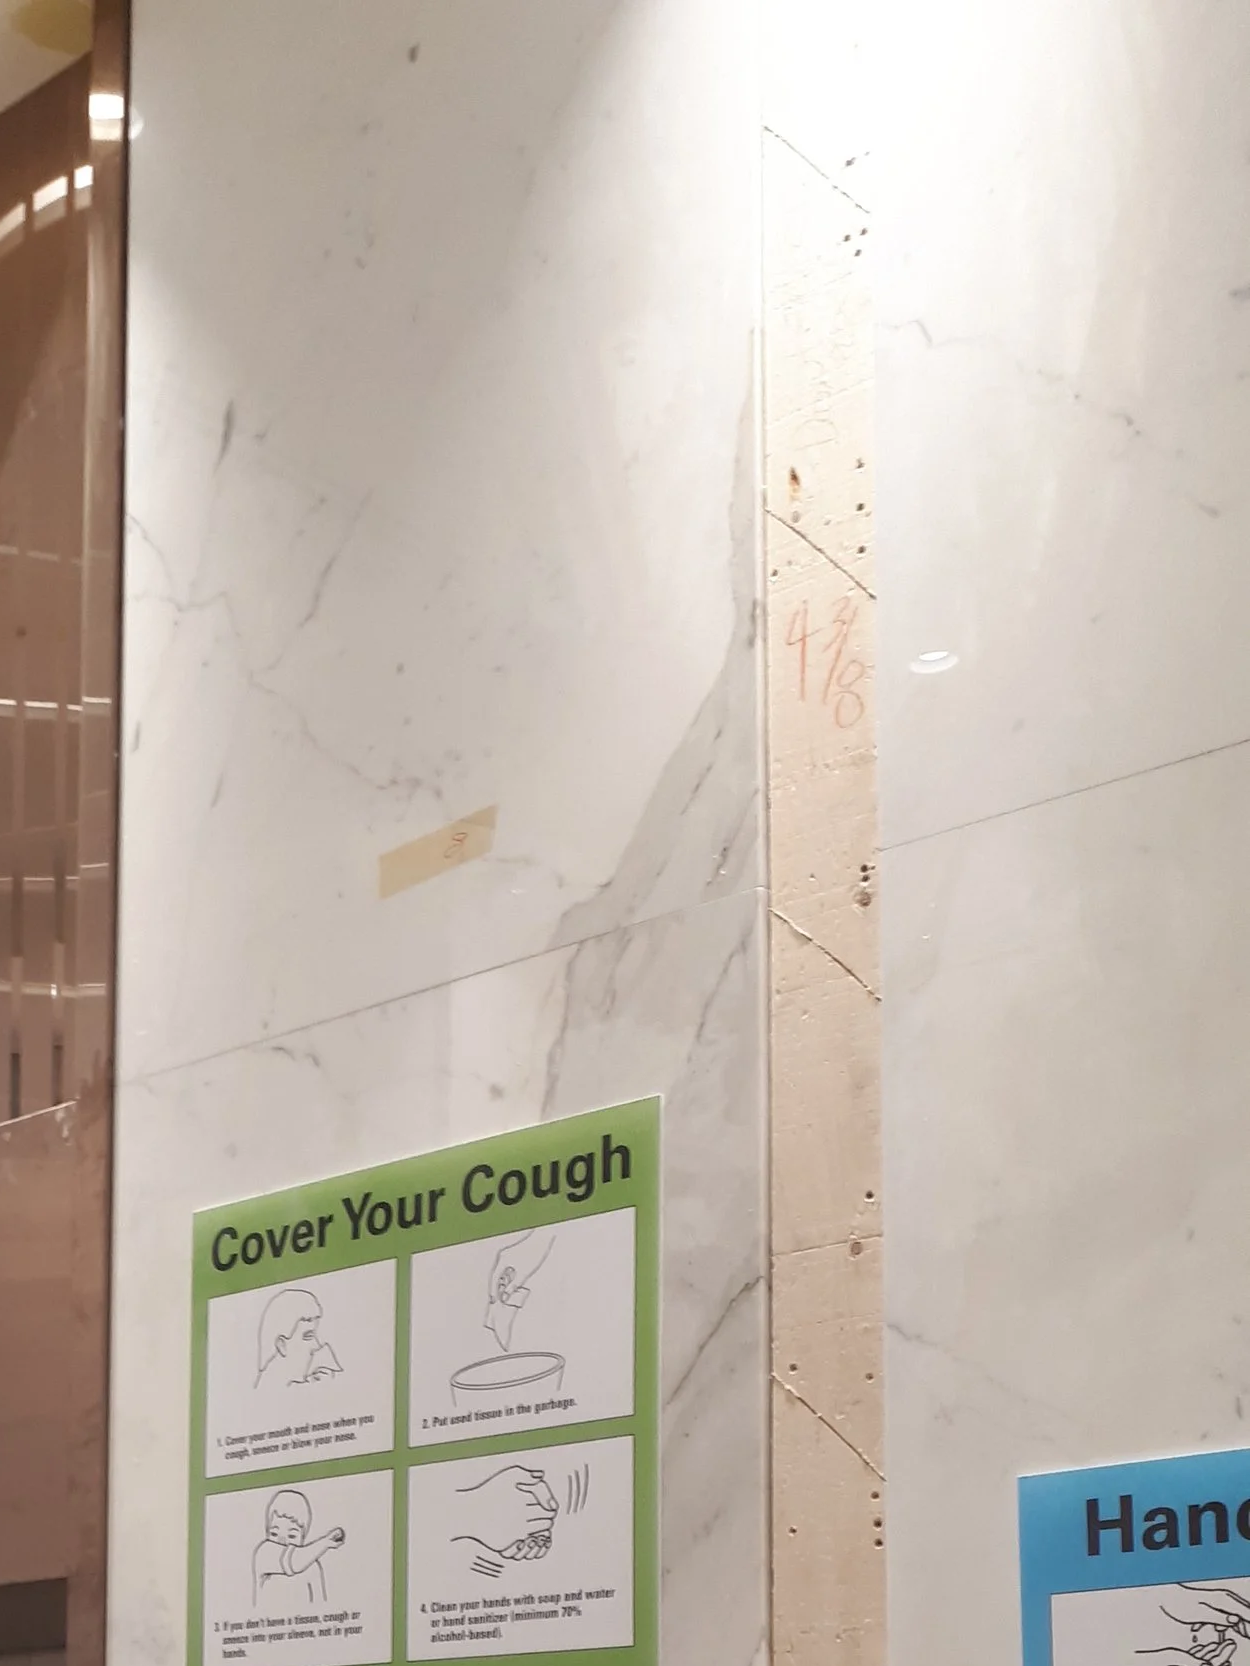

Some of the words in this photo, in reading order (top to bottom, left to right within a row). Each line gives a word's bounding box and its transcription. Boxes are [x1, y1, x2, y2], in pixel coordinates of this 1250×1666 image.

[211, 1214, 334, 1272] Cover
[341, 1186, 447, 1240] Your
[461, 1133, 632, 1215] Cough
[432, 1416, 448, 1428] Put
[450, 1412, 472, 1425] used
[474, 1409, 503, 1421] tissue
[505, 1406, 515, 1417] in
[516, 1403, 531, 1415] the
[534, 1398, 577, 1414] garbage.
[430, 1602, 458, 1613] Clean
[460, 1600, 480, 1613] your
[482, 1597, 512, 1609] hands
[514, 1594, 535, 1605] with
[538, 1593, 561, 1606] soap
[564, 1589, 582, 1601] and
[585, 1588, 615, 1600] water
[430, 1619, 440, 1629] or
[442, 1615, 466, 1627] hand
[468, 1612, 508, 1625] sanitizer
[510, 1608, 559, 1622] (minimum
[561, 1605, 582, 1618] 70%
[430, 1627, 503, 1643] alcohol-based).
